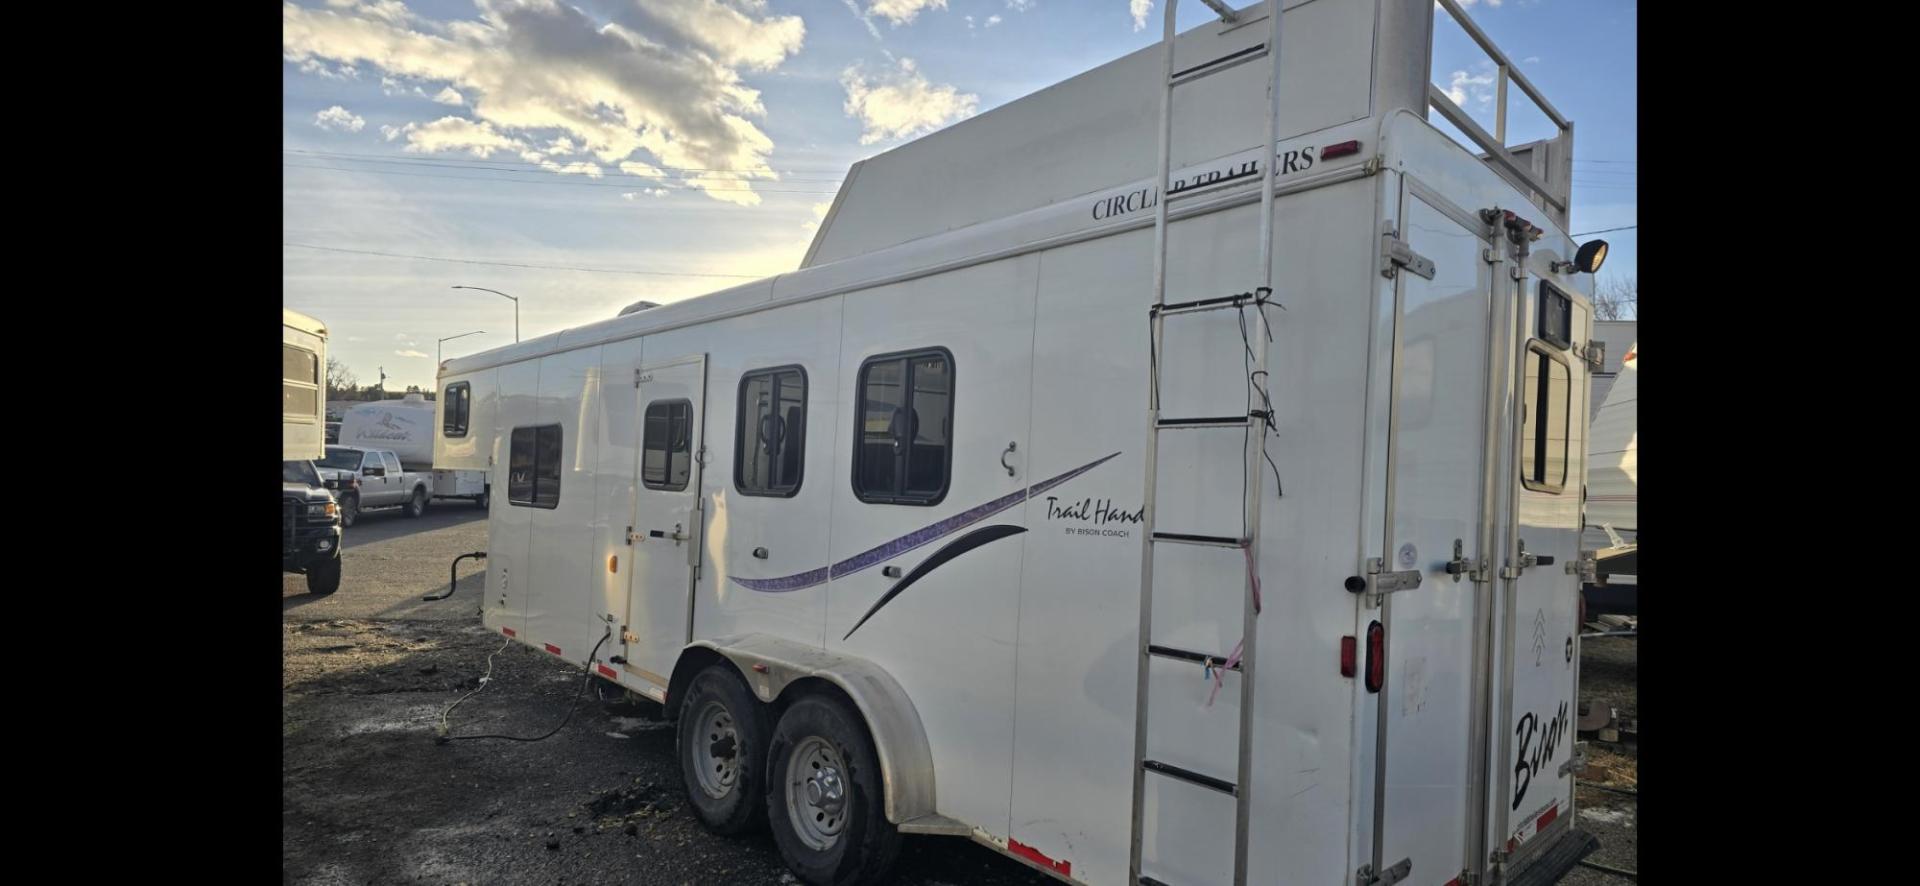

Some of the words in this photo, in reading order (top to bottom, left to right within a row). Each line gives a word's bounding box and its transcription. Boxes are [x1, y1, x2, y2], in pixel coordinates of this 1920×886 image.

[1046, 496, 1091, 520] Trail
[1094, 498, 1145, 525] Hand
[1065, 527, 1076, 535] BY
[1077, 528, 1100, 536] BISON
[1102, 529, 1129, 538] COACH
